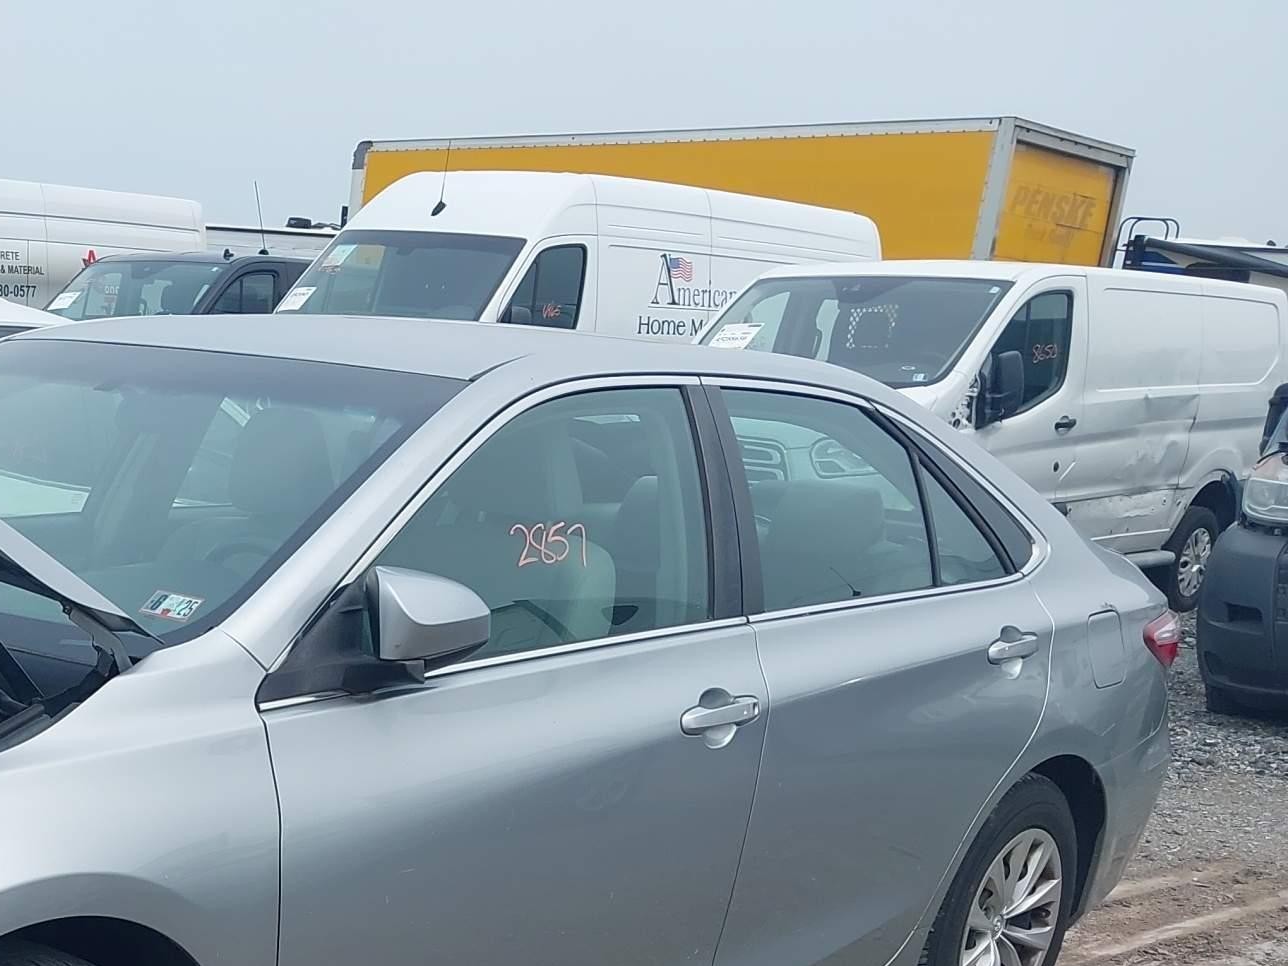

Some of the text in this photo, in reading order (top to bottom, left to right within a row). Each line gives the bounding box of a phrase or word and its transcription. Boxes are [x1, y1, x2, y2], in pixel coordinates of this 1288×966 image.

[0, 264, 6, 274] &
[7, 265, 45, 275] MATERIAL
[637, 315, 686, 337] Home
[690, 317, 705, 337] M
[509, 521, 587, 568] 2857
